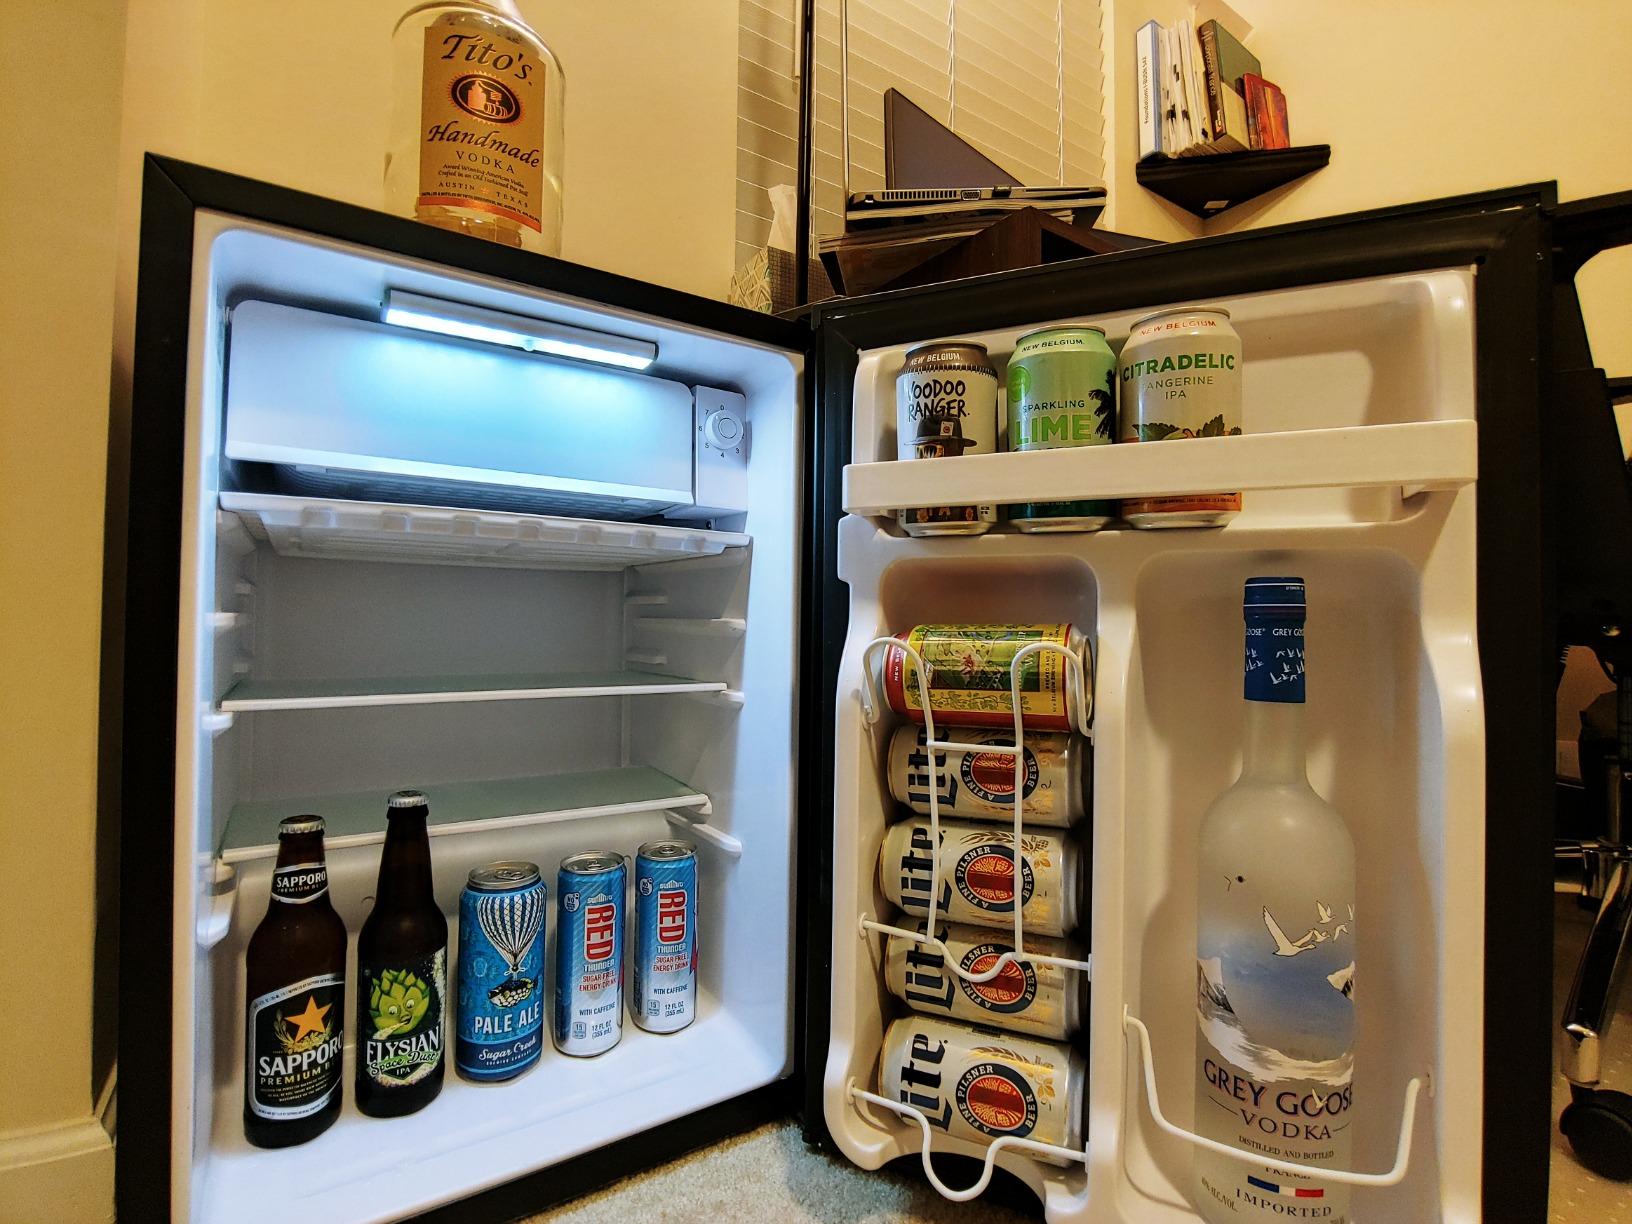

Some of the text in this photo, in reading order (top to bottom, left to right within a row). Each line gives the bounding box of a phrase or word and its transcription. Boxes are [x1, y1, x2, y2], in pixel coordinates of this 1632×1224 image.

[441, 34, 532, 80] Tito's
[427, 121, 540, 168] Handmade
[456, 150, 514, 174] VODKA
[438, 182, 528, 208] AUSTIN TEXAS
[1141, 320, 1217, 336] NEW BELGIUM
[1022, 339, 1083, 352] NEW BELGIUM
[910, 352, 961, 366] NEW BELGIUM
[1123, 353, 1235, 382] CITRADELIC
[908, 379, 966, 402] VOODOO
[1146, 376, 1214, 390] ANGERINE
[1165, 390, 1186, 400] IPA
[1022, 400, 1085, 413] SPARKLING
[1016, 414, 1092, 445] LIME
[1272, 628, 1292, 636] GREY
[1027, 758, 1036, 788] BEER
[964, 775, 984, 797] FINE
[901, 827, 952, 914] Lite
[956, 846, 992, 878] PILSNER
[276, 870, 326, 888] SAPPORO
[1022, 866, 1033, 898] BEER
[958, 882, 980, 904] FINE
[659, 891, 686, 944] RED
[586, 904, 614, 960] RED
[674, 954, 686, 962] FREE
[674, 962, 688, 970] DRINK
[962, 946, 995, 970] ILSNER
[579, 983, 600, 992] ENERGY
[582, 970, 614, 982] SUGAR FREE
[1024, 968, 1034, 1000] BEER
[666, 984, 688, 994] CAFFEINE
[962, 980, 981, 1004] FINE
[474, 1001, 540, 1034] PALE ALE
[594, 1002, 616, 1014] CAFFEINE
[260, 1030, 344, 1076] SAPPORO
[366, 1026, 439, 1064] ELYSIAN
[478, 1035, 536, 1060] Sugar Creek
[260, 1066, 321, 1085] PREMIUM
[370, 1050, 437, 1076] Space Dust
[396, 1066, 410, 1076] IPA
[900, 1034, 953, 1132] Lite
[958, 1065, 994, 1098] PILSNER
[1204, 1059, 1265, 1107] GREY
[960, 1102, 980, 1126] FINE
[1025, 1094, 1036, 1128] BEER
[1240, 1108, 1332, 1140] VODKA
[1238, 1135, 1334, 1160] DISTILLED AND BOTTLED
[1236, 1188, 1332, 1218] IMPORTED
